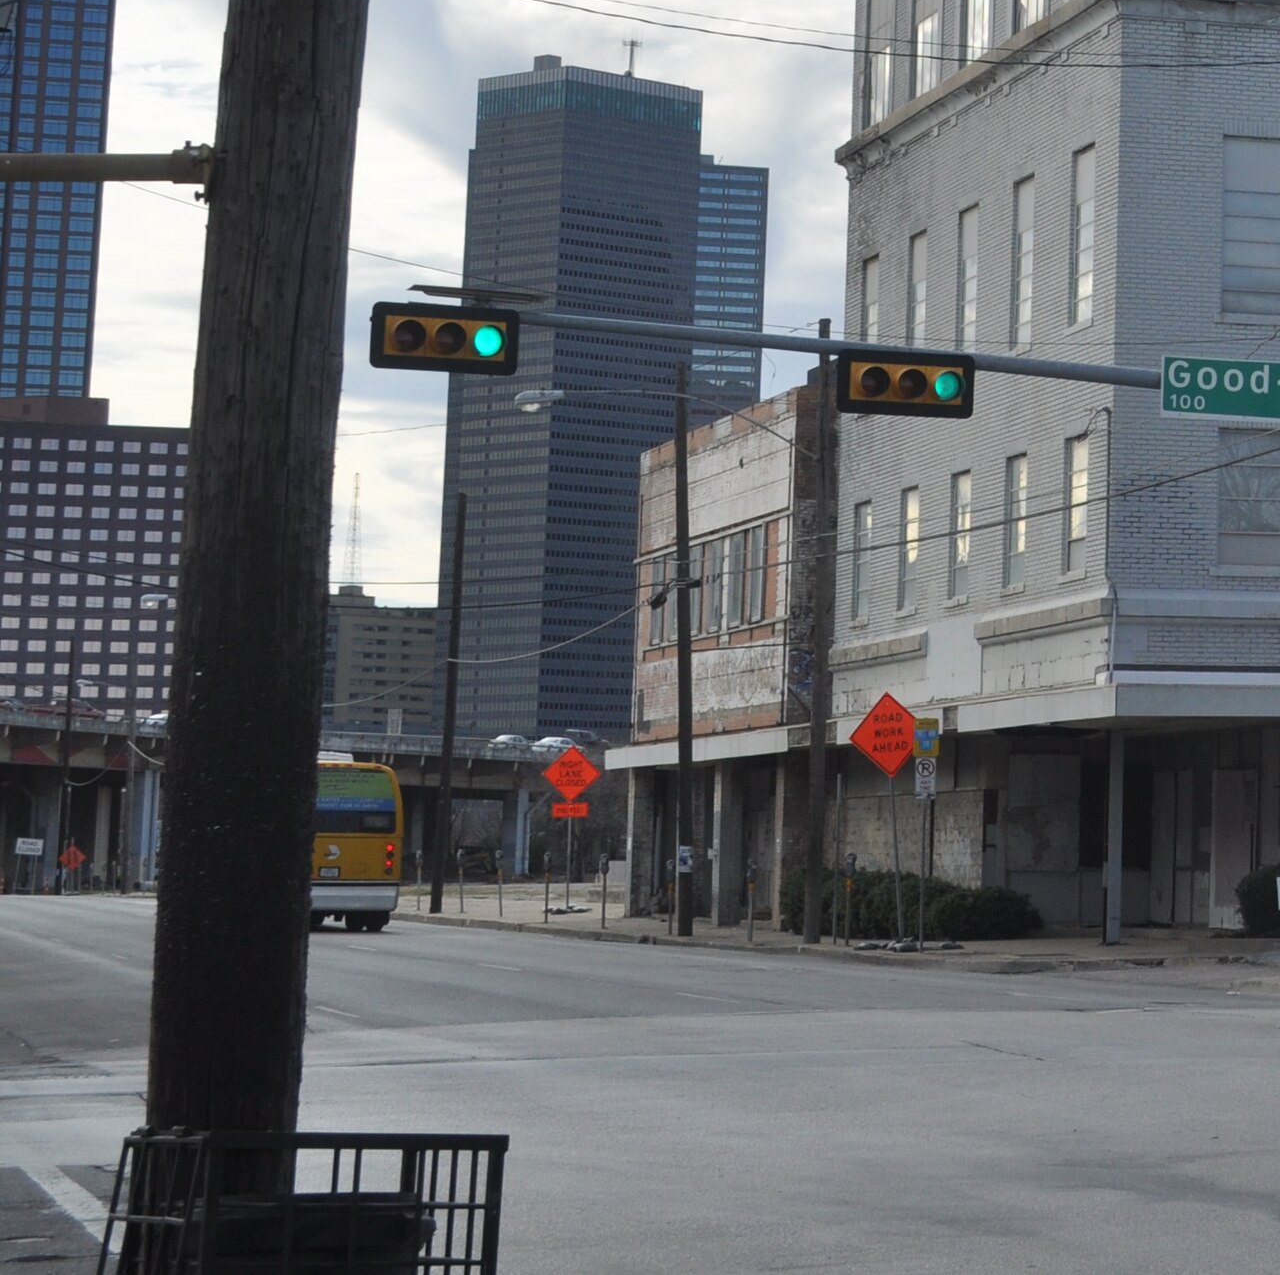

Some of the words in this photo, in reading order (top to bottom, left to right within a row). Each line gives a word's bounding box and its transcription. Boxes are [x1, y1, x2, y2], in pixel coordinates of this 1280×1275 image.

[1170, 394, 1205, 410] 100
[873, 713, 902, 724] ROAD
[874, 727, 904, 738] WORK
[872, 741, 908, 753] AHEAD
[559, 770, 583, 778] LANE
[556, 779, 587, 787] CLOSED
